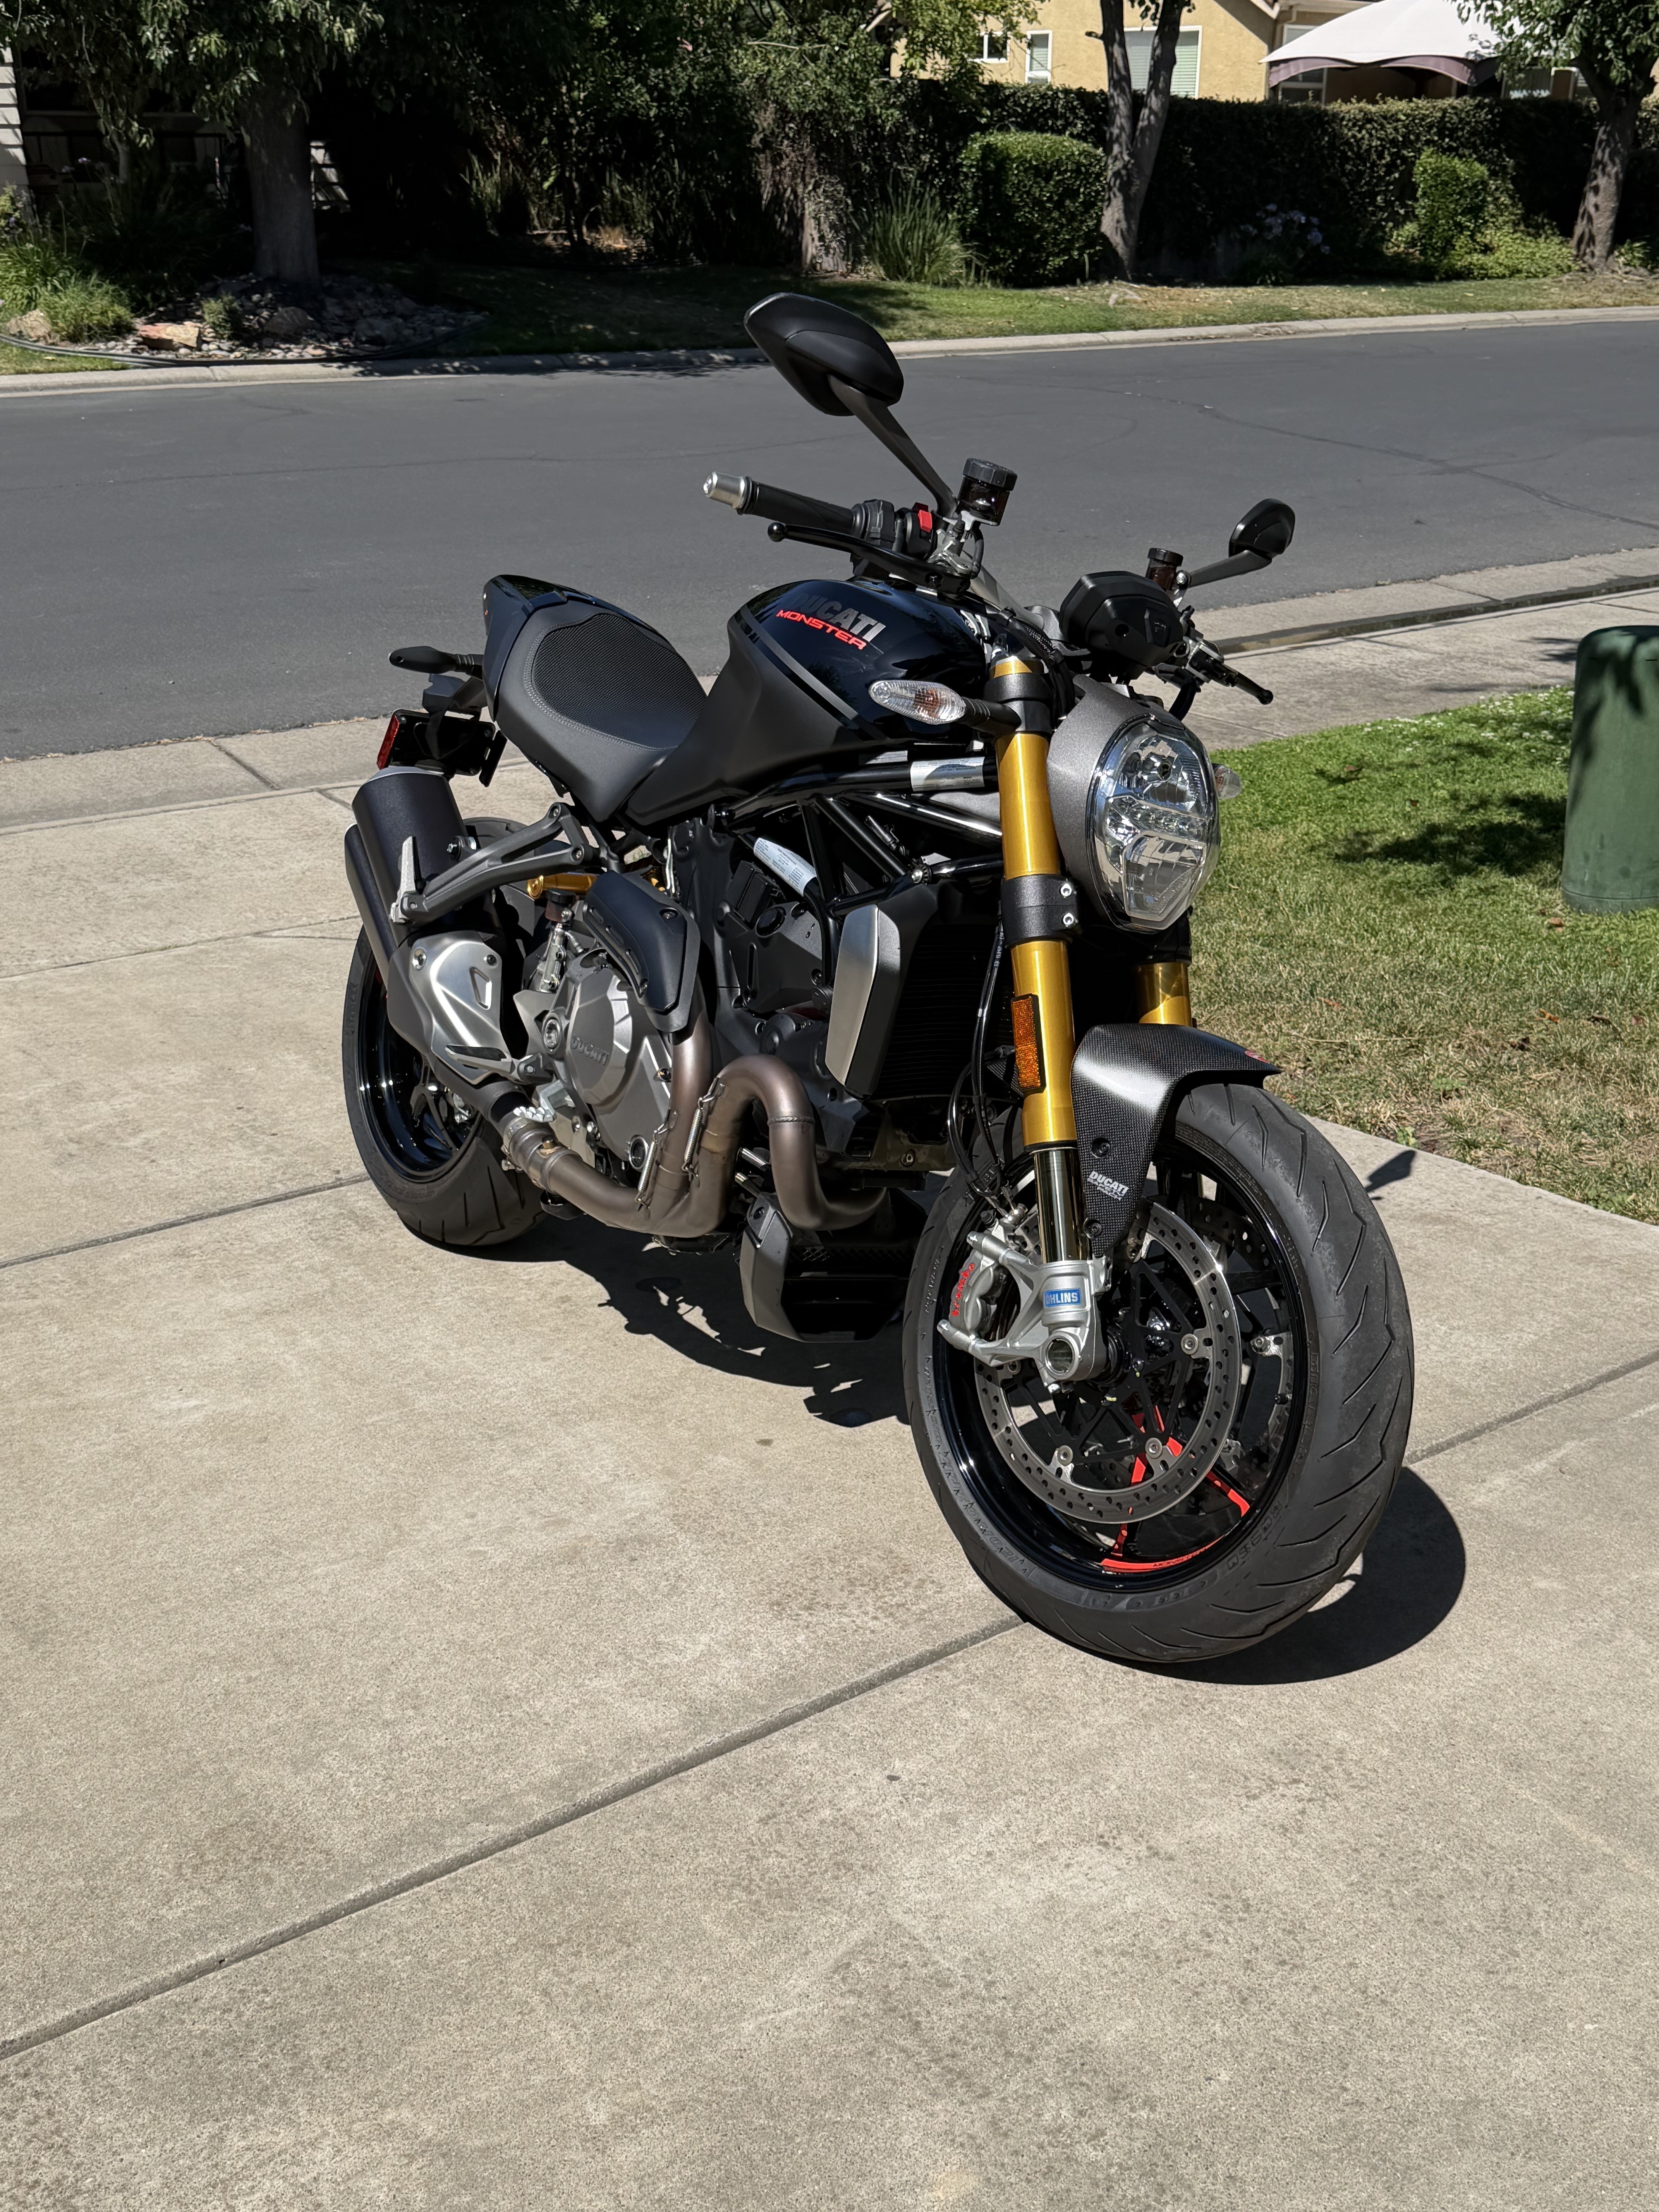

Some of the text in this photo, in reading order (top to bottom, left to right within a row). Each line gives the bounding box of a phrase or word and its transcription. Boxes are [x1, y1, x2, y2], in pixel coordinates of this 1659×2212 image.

[776, 609, 867, 650] MONSTER
[791, 593, 886, 642] DUCATI
[570, 1036, 610, 1066] DUCATI
[1089, 1171, 1129, 1194] DUCATI
